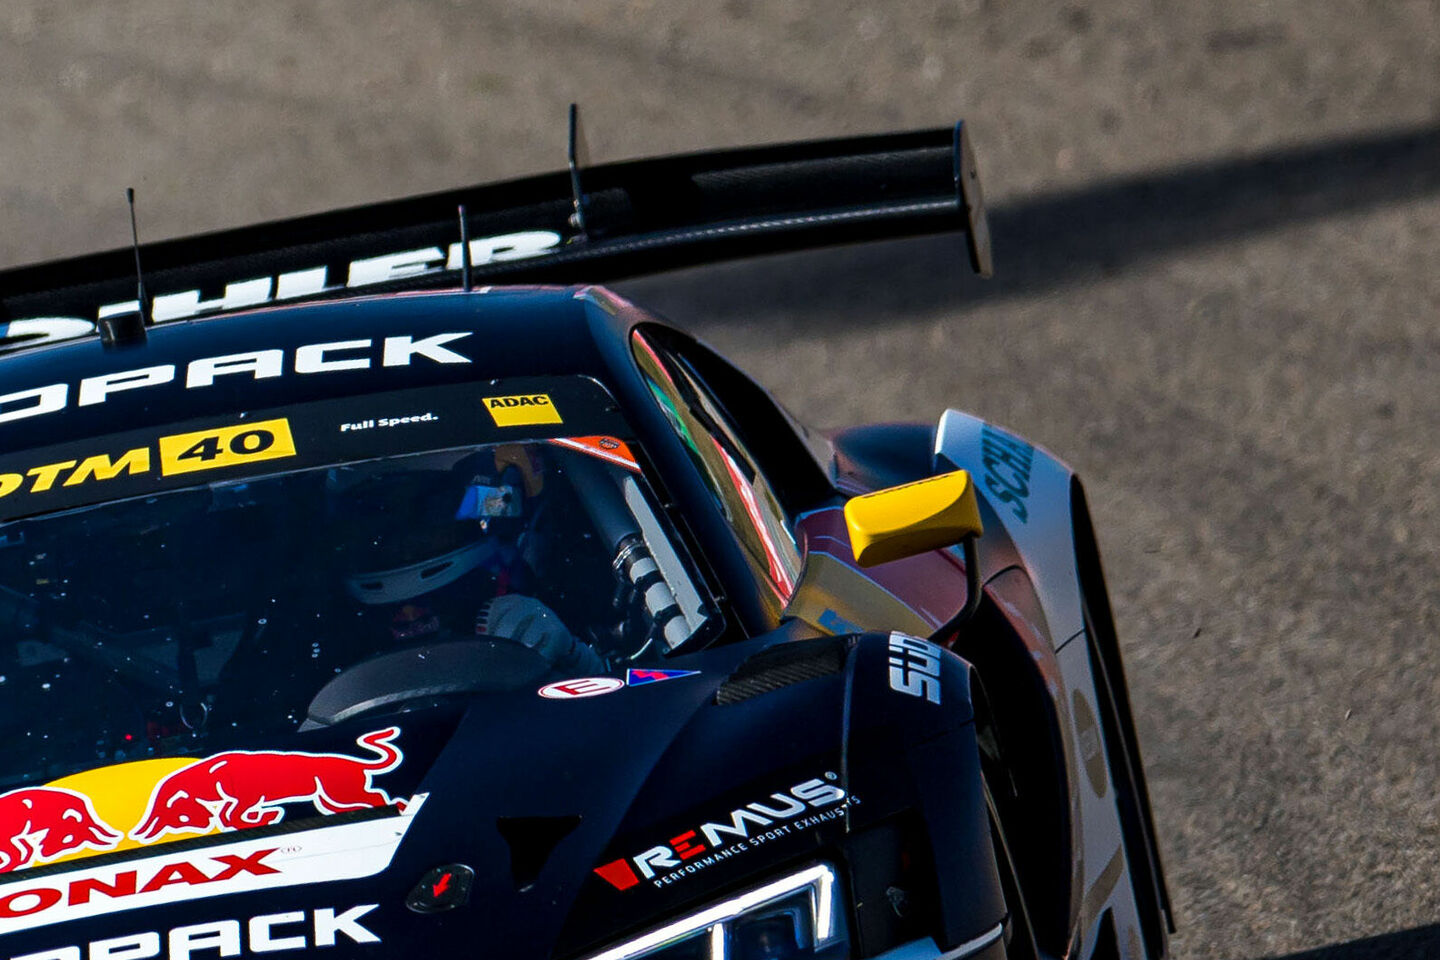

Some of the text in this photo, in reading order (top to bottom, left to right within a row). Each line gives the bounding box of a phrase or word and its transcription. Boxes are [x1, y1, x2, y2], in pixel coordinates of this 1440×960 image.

[490, 395, 549, 409] ADAC
[340, 412, 439, 432] Full Speed.
[177, 429, 276, 461] 40
[632, 778, 846, 880] REMUS
[653, 840, 749, 889] PERFORMANCE
[749, 824, 792, 848] SPORT
